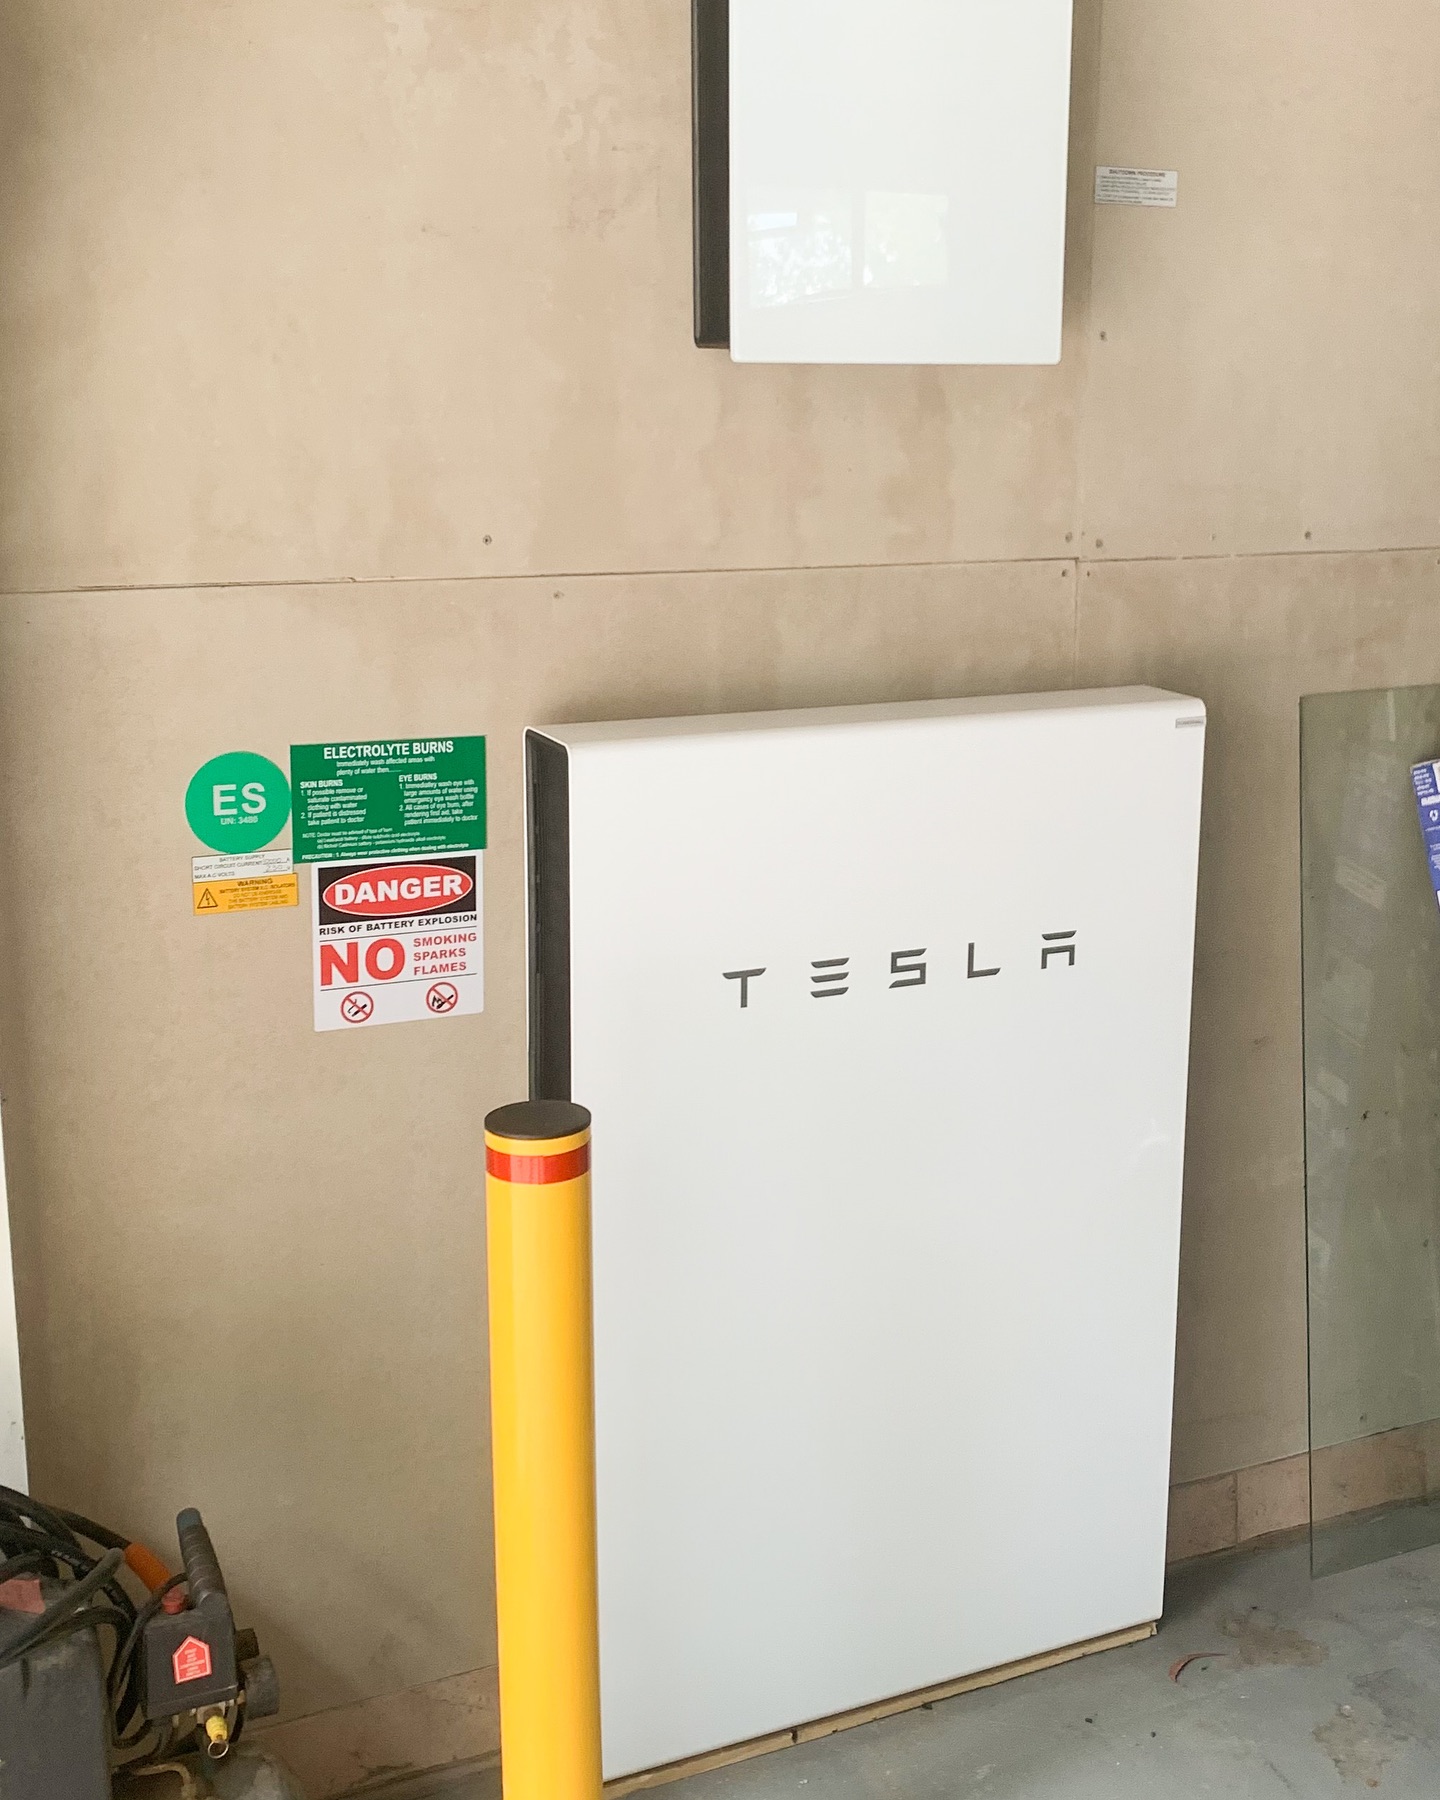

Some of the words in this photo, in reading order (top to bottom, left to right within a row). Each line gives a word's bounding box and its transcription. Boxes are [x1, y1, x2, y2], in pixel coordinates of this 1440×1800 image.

[324, 743, 409, 759] ELECTROLYTE
[412, 741, 454, 754] BURNS
[336, 759, 369, 767] Immediately
[386, 757, 407, 765] affected
[336, 768, 353, 776] plenty
[399, 774, 412, 782] EYE
[414, 773, 437, 781] BURNS
[300, 781, 317, 789] SKIN
[318, 779, 343, 788] BURNS
[213, 782, 266, 816] ES
[312, 789, 335, 797] possible
[331, 794, 367, 802] contaminated
[338, 808, 366, 816] distressed
[237, 878, 273, 887] WARNING
[335, 874, 463, 906] DANGER
[319, 926, 345, 935] RISK
[348, 924, 362, 932] OF
[366, 920, 415, 931] BATTERY
[418, 914, 477, 926] EXPLOSION
[413, 932, 477, 948] SMOKING
[413, 948, 466, 961] SPARKS
[320, 938, 405, 986] NO
[414, 962, 466, 975] FLAMES
[722, 930, 1077, 1008] TESLA
